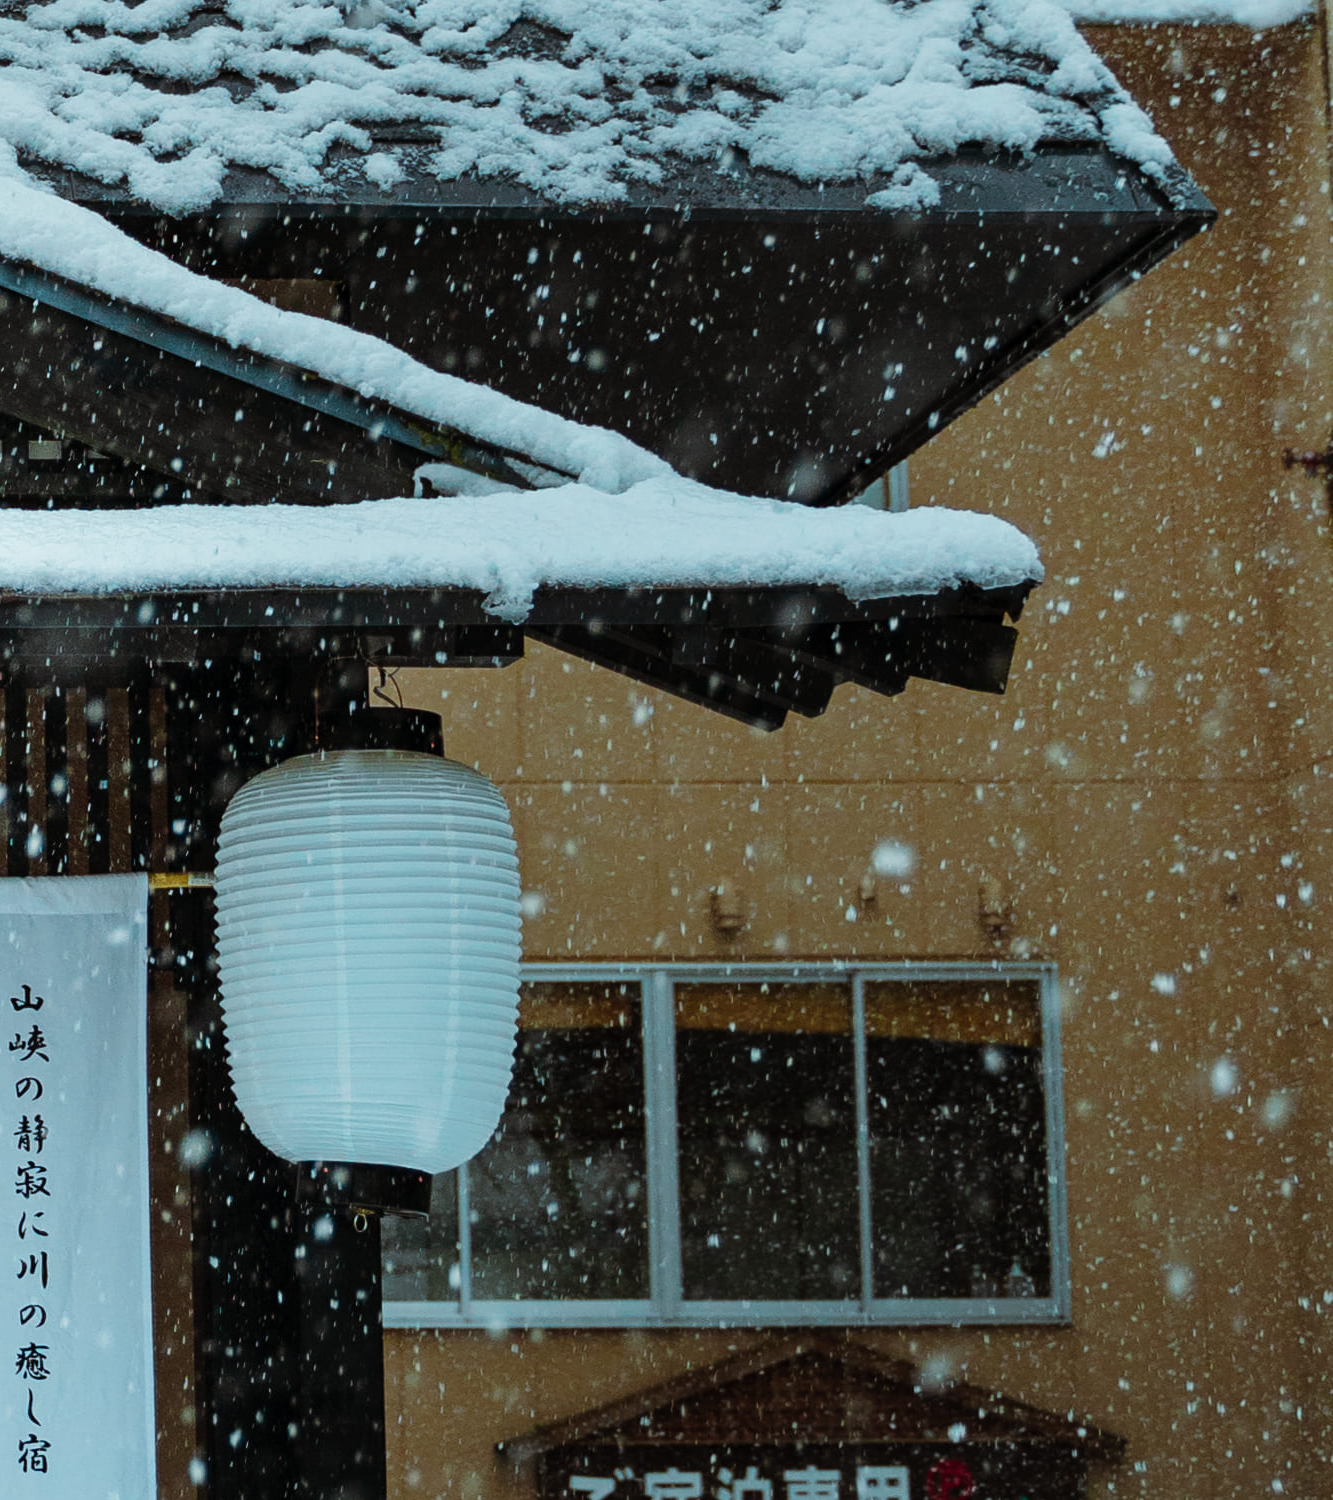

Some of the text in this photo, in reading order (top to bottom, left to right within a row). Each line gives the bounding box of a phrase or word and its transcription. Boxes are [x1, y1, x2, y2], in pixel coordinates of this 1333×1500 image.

[8, 984, 52, 1474] 山峡の静寂に川の癒し宿
